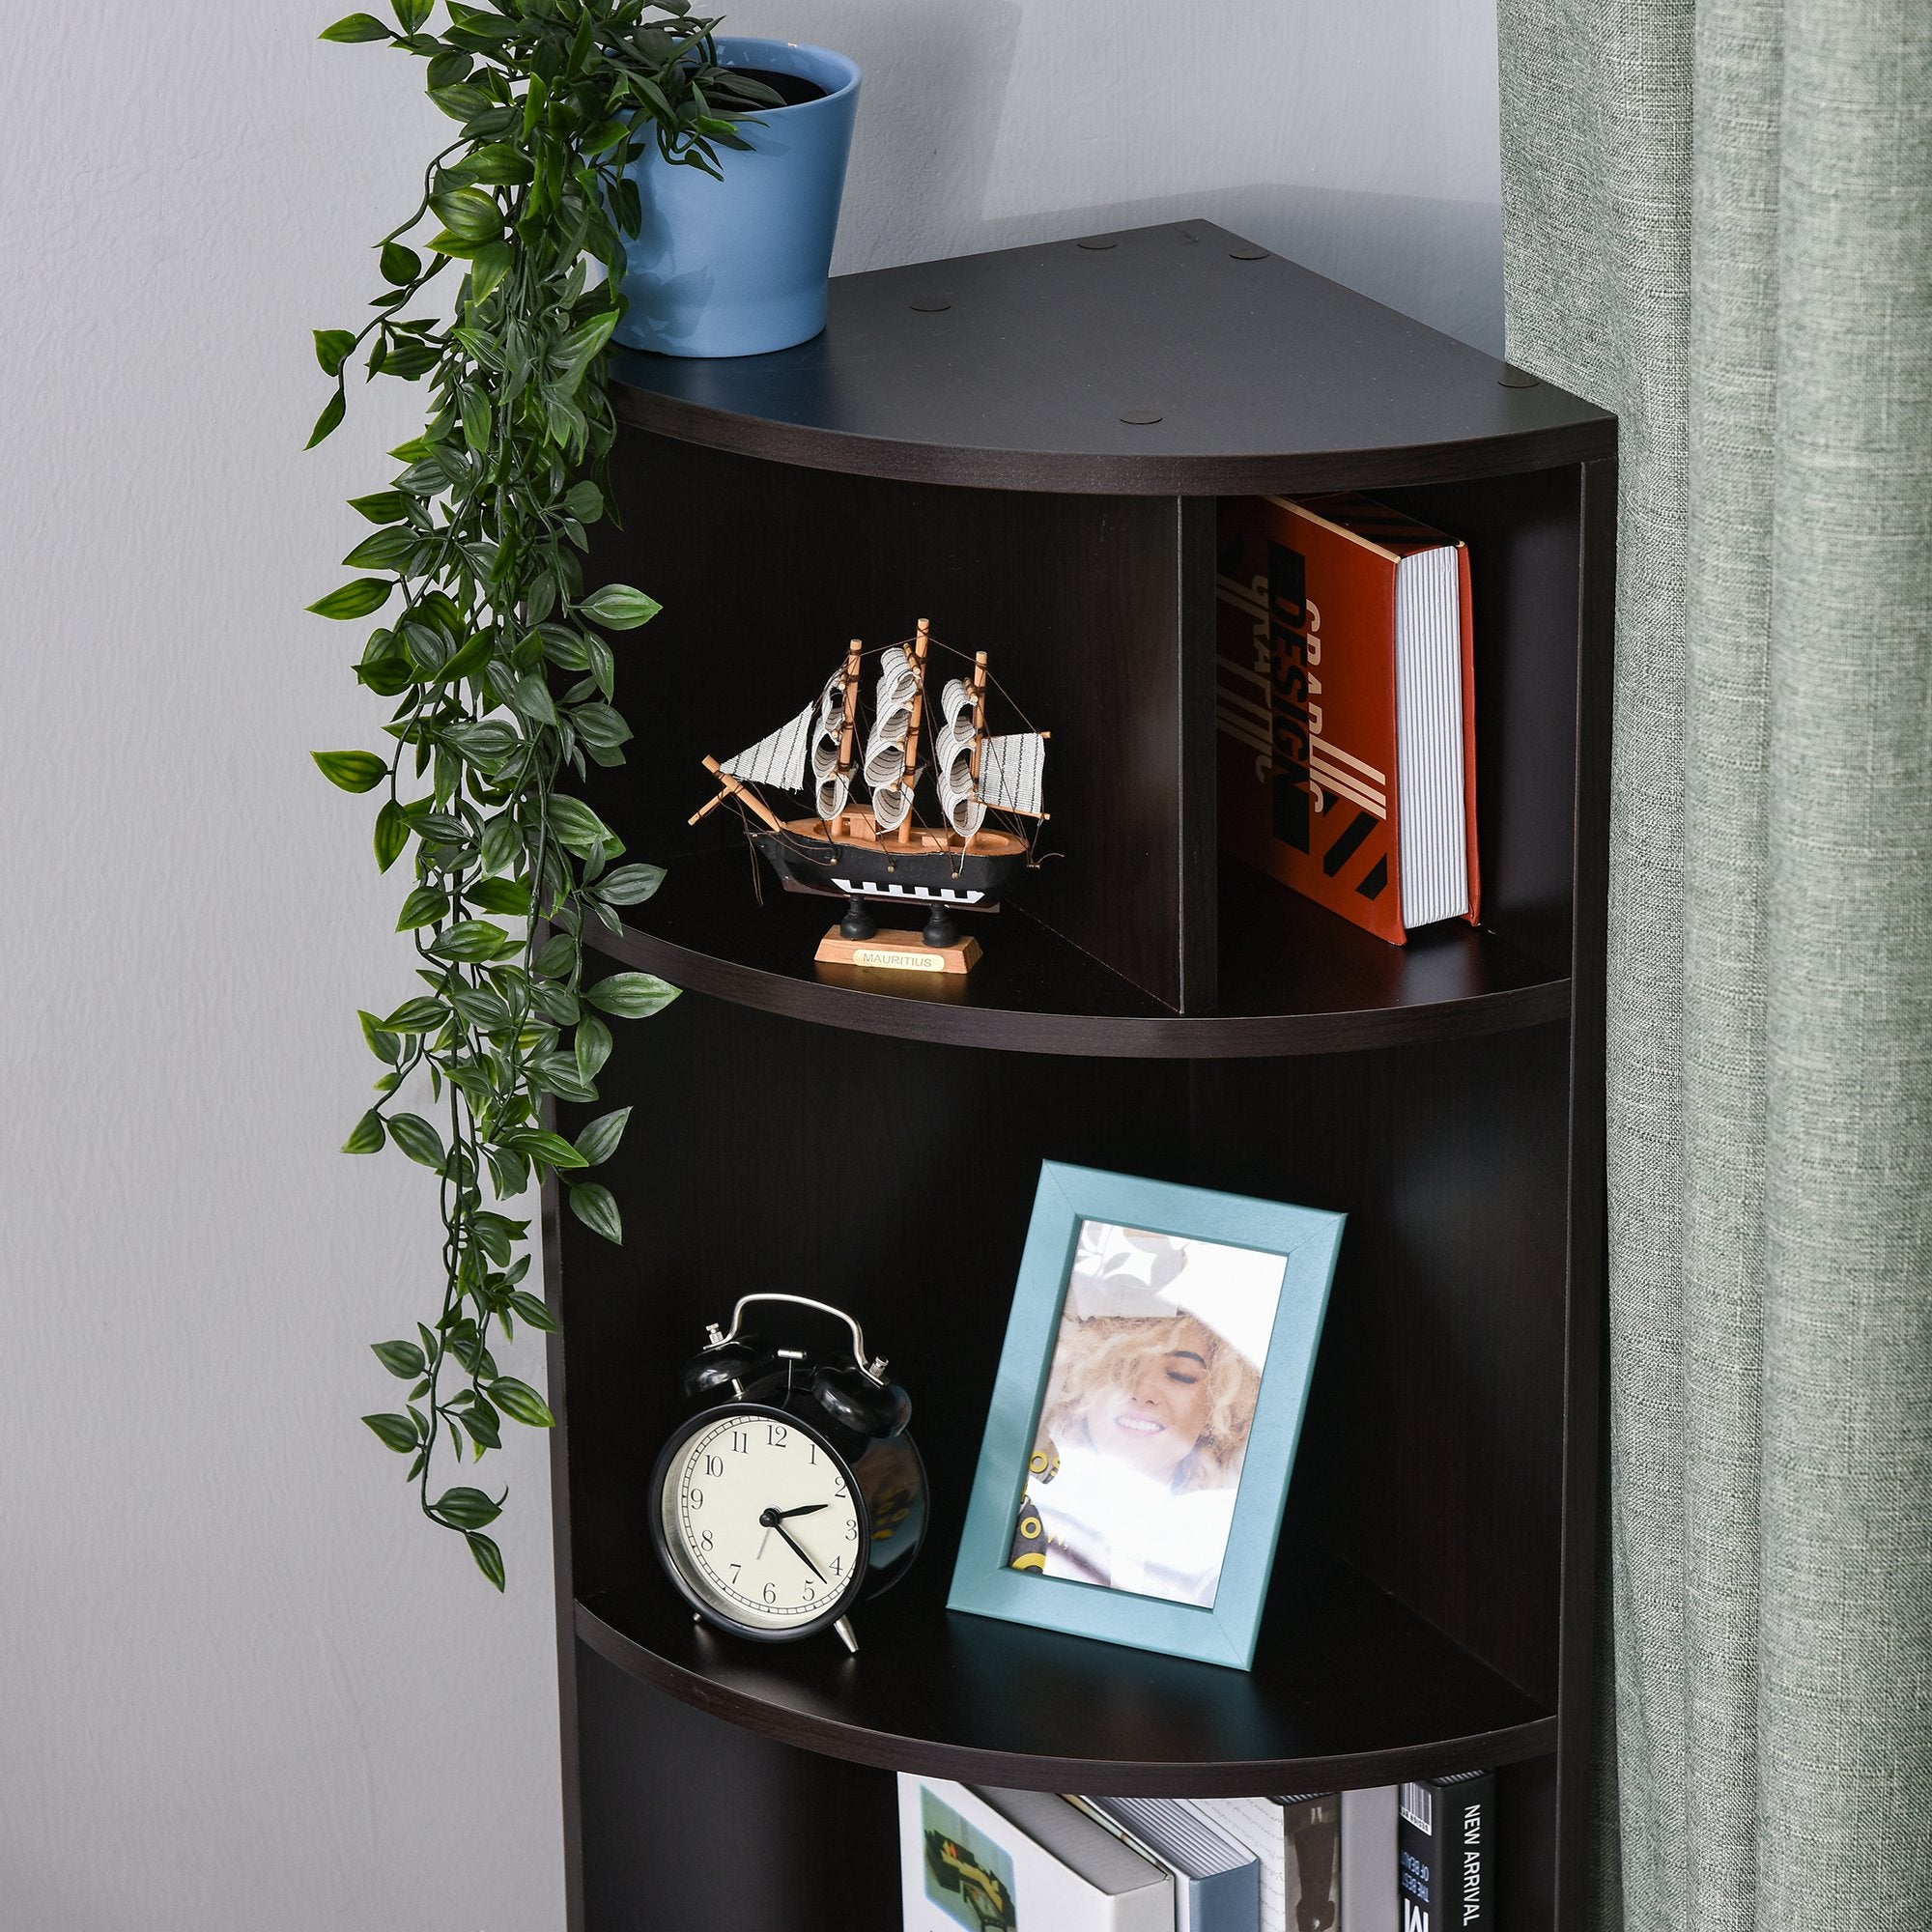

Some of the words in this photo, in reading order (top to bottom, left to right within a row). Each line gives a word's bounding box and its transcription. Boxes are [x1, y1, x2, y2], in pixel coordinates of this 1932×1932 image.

[1270, 585, 1310, 804] DESIGN
[863, 952, 932, 968] MAURITIUS
[732, 1431, 750, 1455] 11
[766, 1425, 788, 1448] 12
[809, 1444, 817, 1465] 1
[704, 1454, 724, 1478] 10
[834, 1476, 848, 1498] 2
[691, 1488, 703, 1510] 9
[701, 1529, 714, 1551] 8
[845, 1519, 858, 1541] 3
[728, 1563, 742, 1584] 7
[829, 1555, 843, 1577] 4
[763, 1582, 777, 1605] 6
[802, 1580, 815, 1601] 5
[1463, 1804, 1481, 1845] NEW
[1463, 1851, 1481, 1927] ARRIVAL
